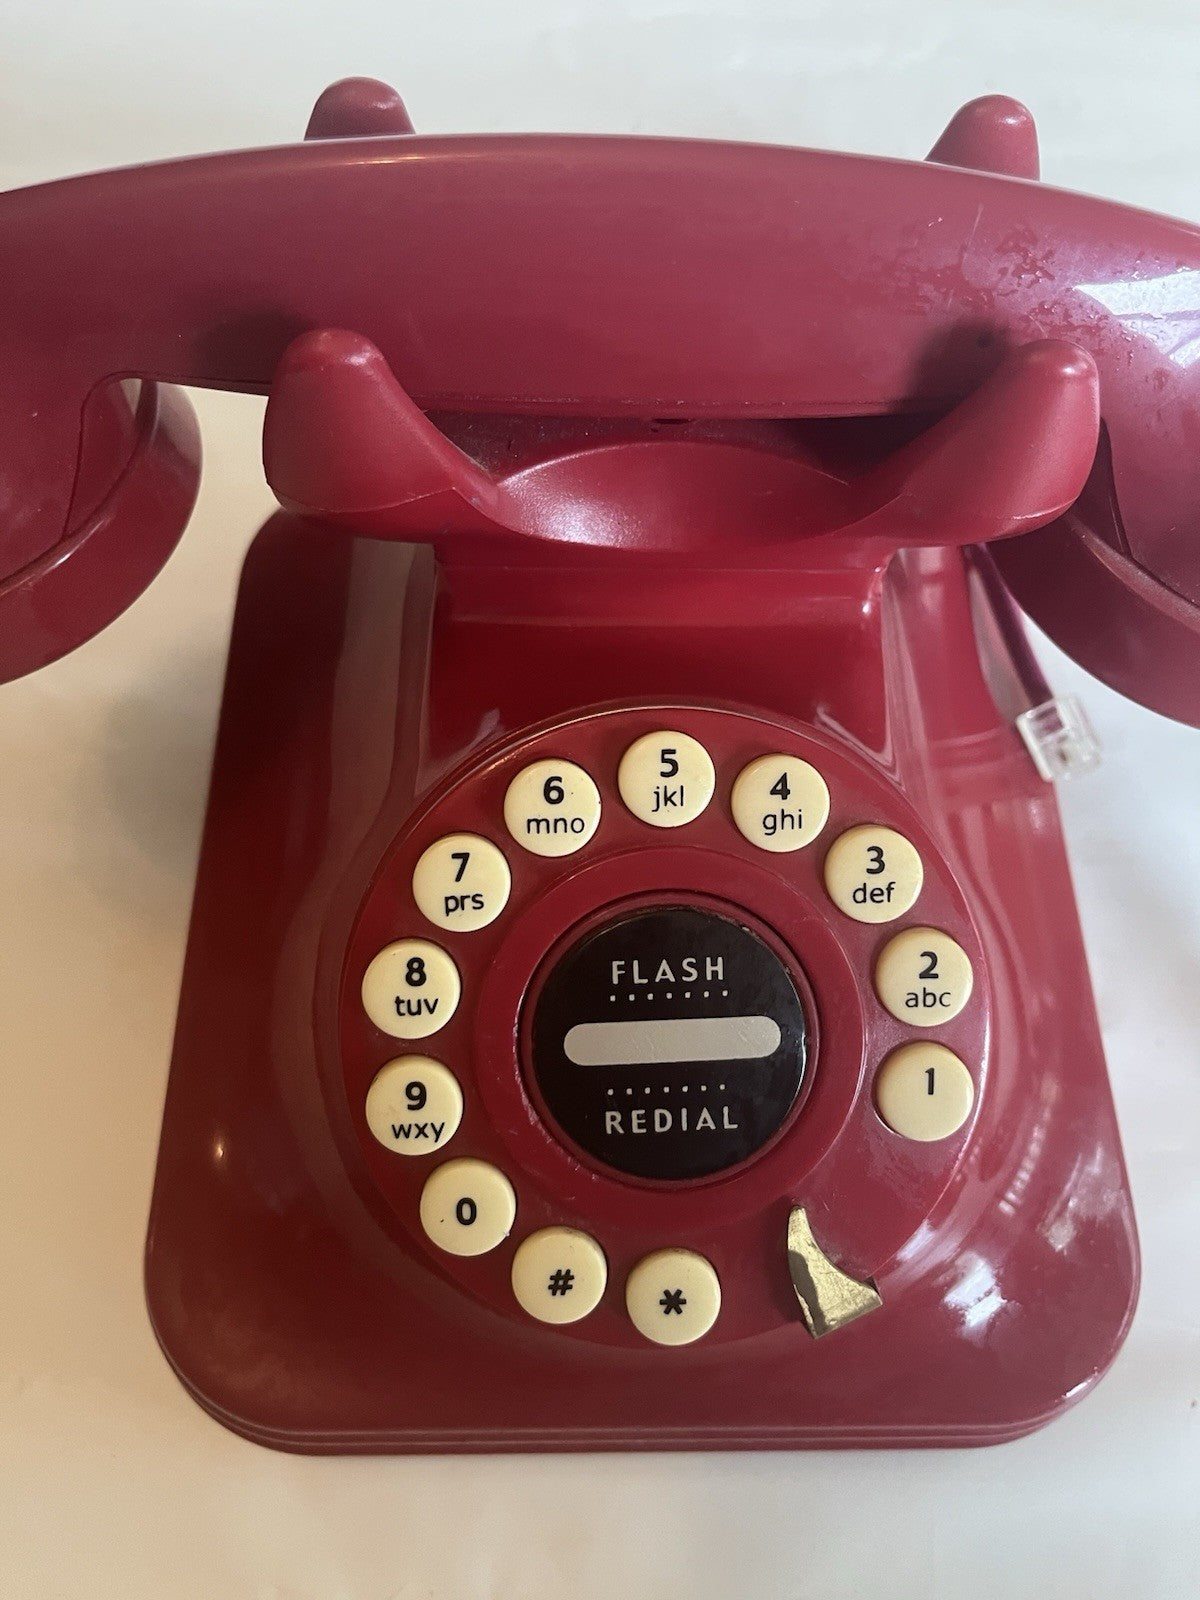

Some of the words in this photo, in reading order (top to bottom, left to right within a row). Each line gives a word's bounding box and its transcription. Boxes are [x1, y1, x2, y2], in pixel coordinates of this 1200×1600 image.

[659, 748, 679, 779] 5
[543, 775, 565, 805] 6
[651, 784, 684, 813] jkl
[768, 771, 791, 801] 4
[526, 817, 585, 835] mno
[762, 808, 802, 836] ghi
[450, 851, 471, 883] 7
[865, 845, 886, 875] 3
[444, 893, 485, 917] prs
[852, 881, 896, 904] def
[404, 956, 427, 988] 8
[611, 956, 724, 985] FLASH
[918, 951, 939, 980] 2
[394, 995, 439, 1017] tuv
[904, 986, 951, 1008] abc
[404, 1080, 428, 1112] 9
[924, 1067, 935, 1096] 1
[391, 1121, 445, 1143] wxy
[604, 1105, 739, 1135] REDIAL
[455, 1196, 478, 1227] 0
[547, 1268, 576, 1297] #
